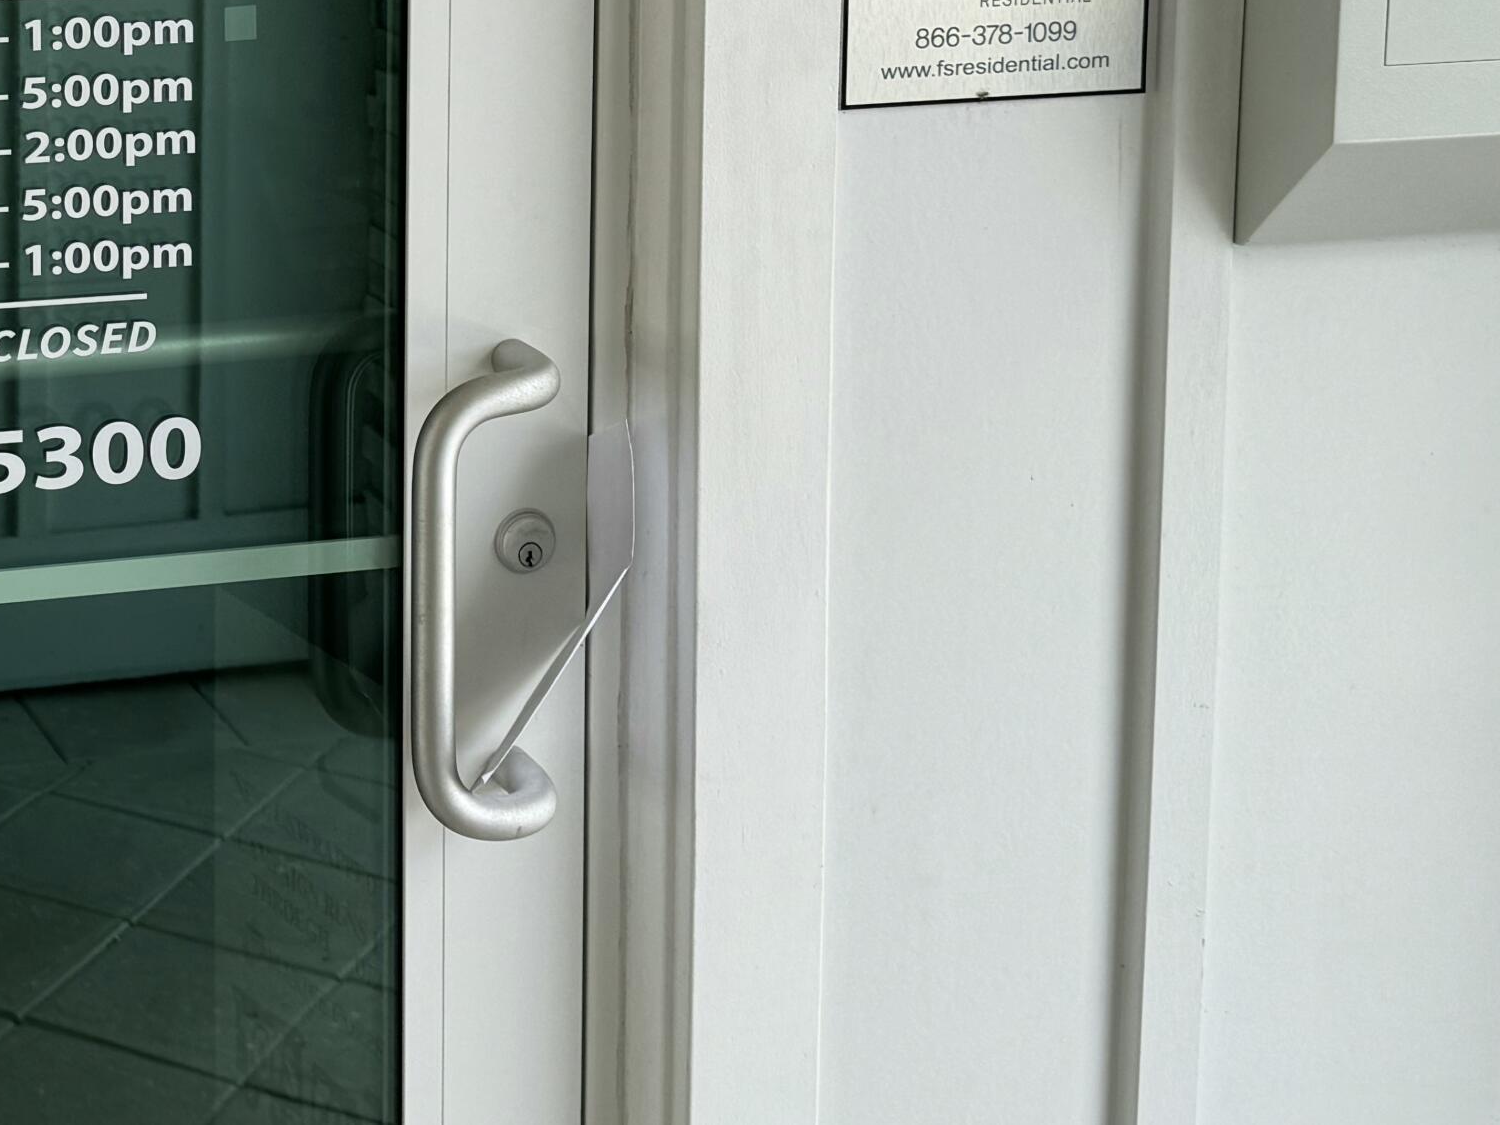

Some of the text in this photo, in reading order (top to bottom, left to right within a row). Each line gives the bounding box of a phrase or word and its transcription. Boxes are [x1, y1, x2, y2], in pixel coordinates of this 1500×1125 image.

[24, 15, 194, 56] 1:00pm
[915, 19, 1078, 50] 866-378-1099
[880, 53, 1111, 80] www.fsresidential.com
[22, 73, 193, 114] 5:00pm
[24, 127, 196, 167] 2:00pm
[22, 184, 192, 225] 5:00pm
[25, 240, 193, 280] 1:00pm
